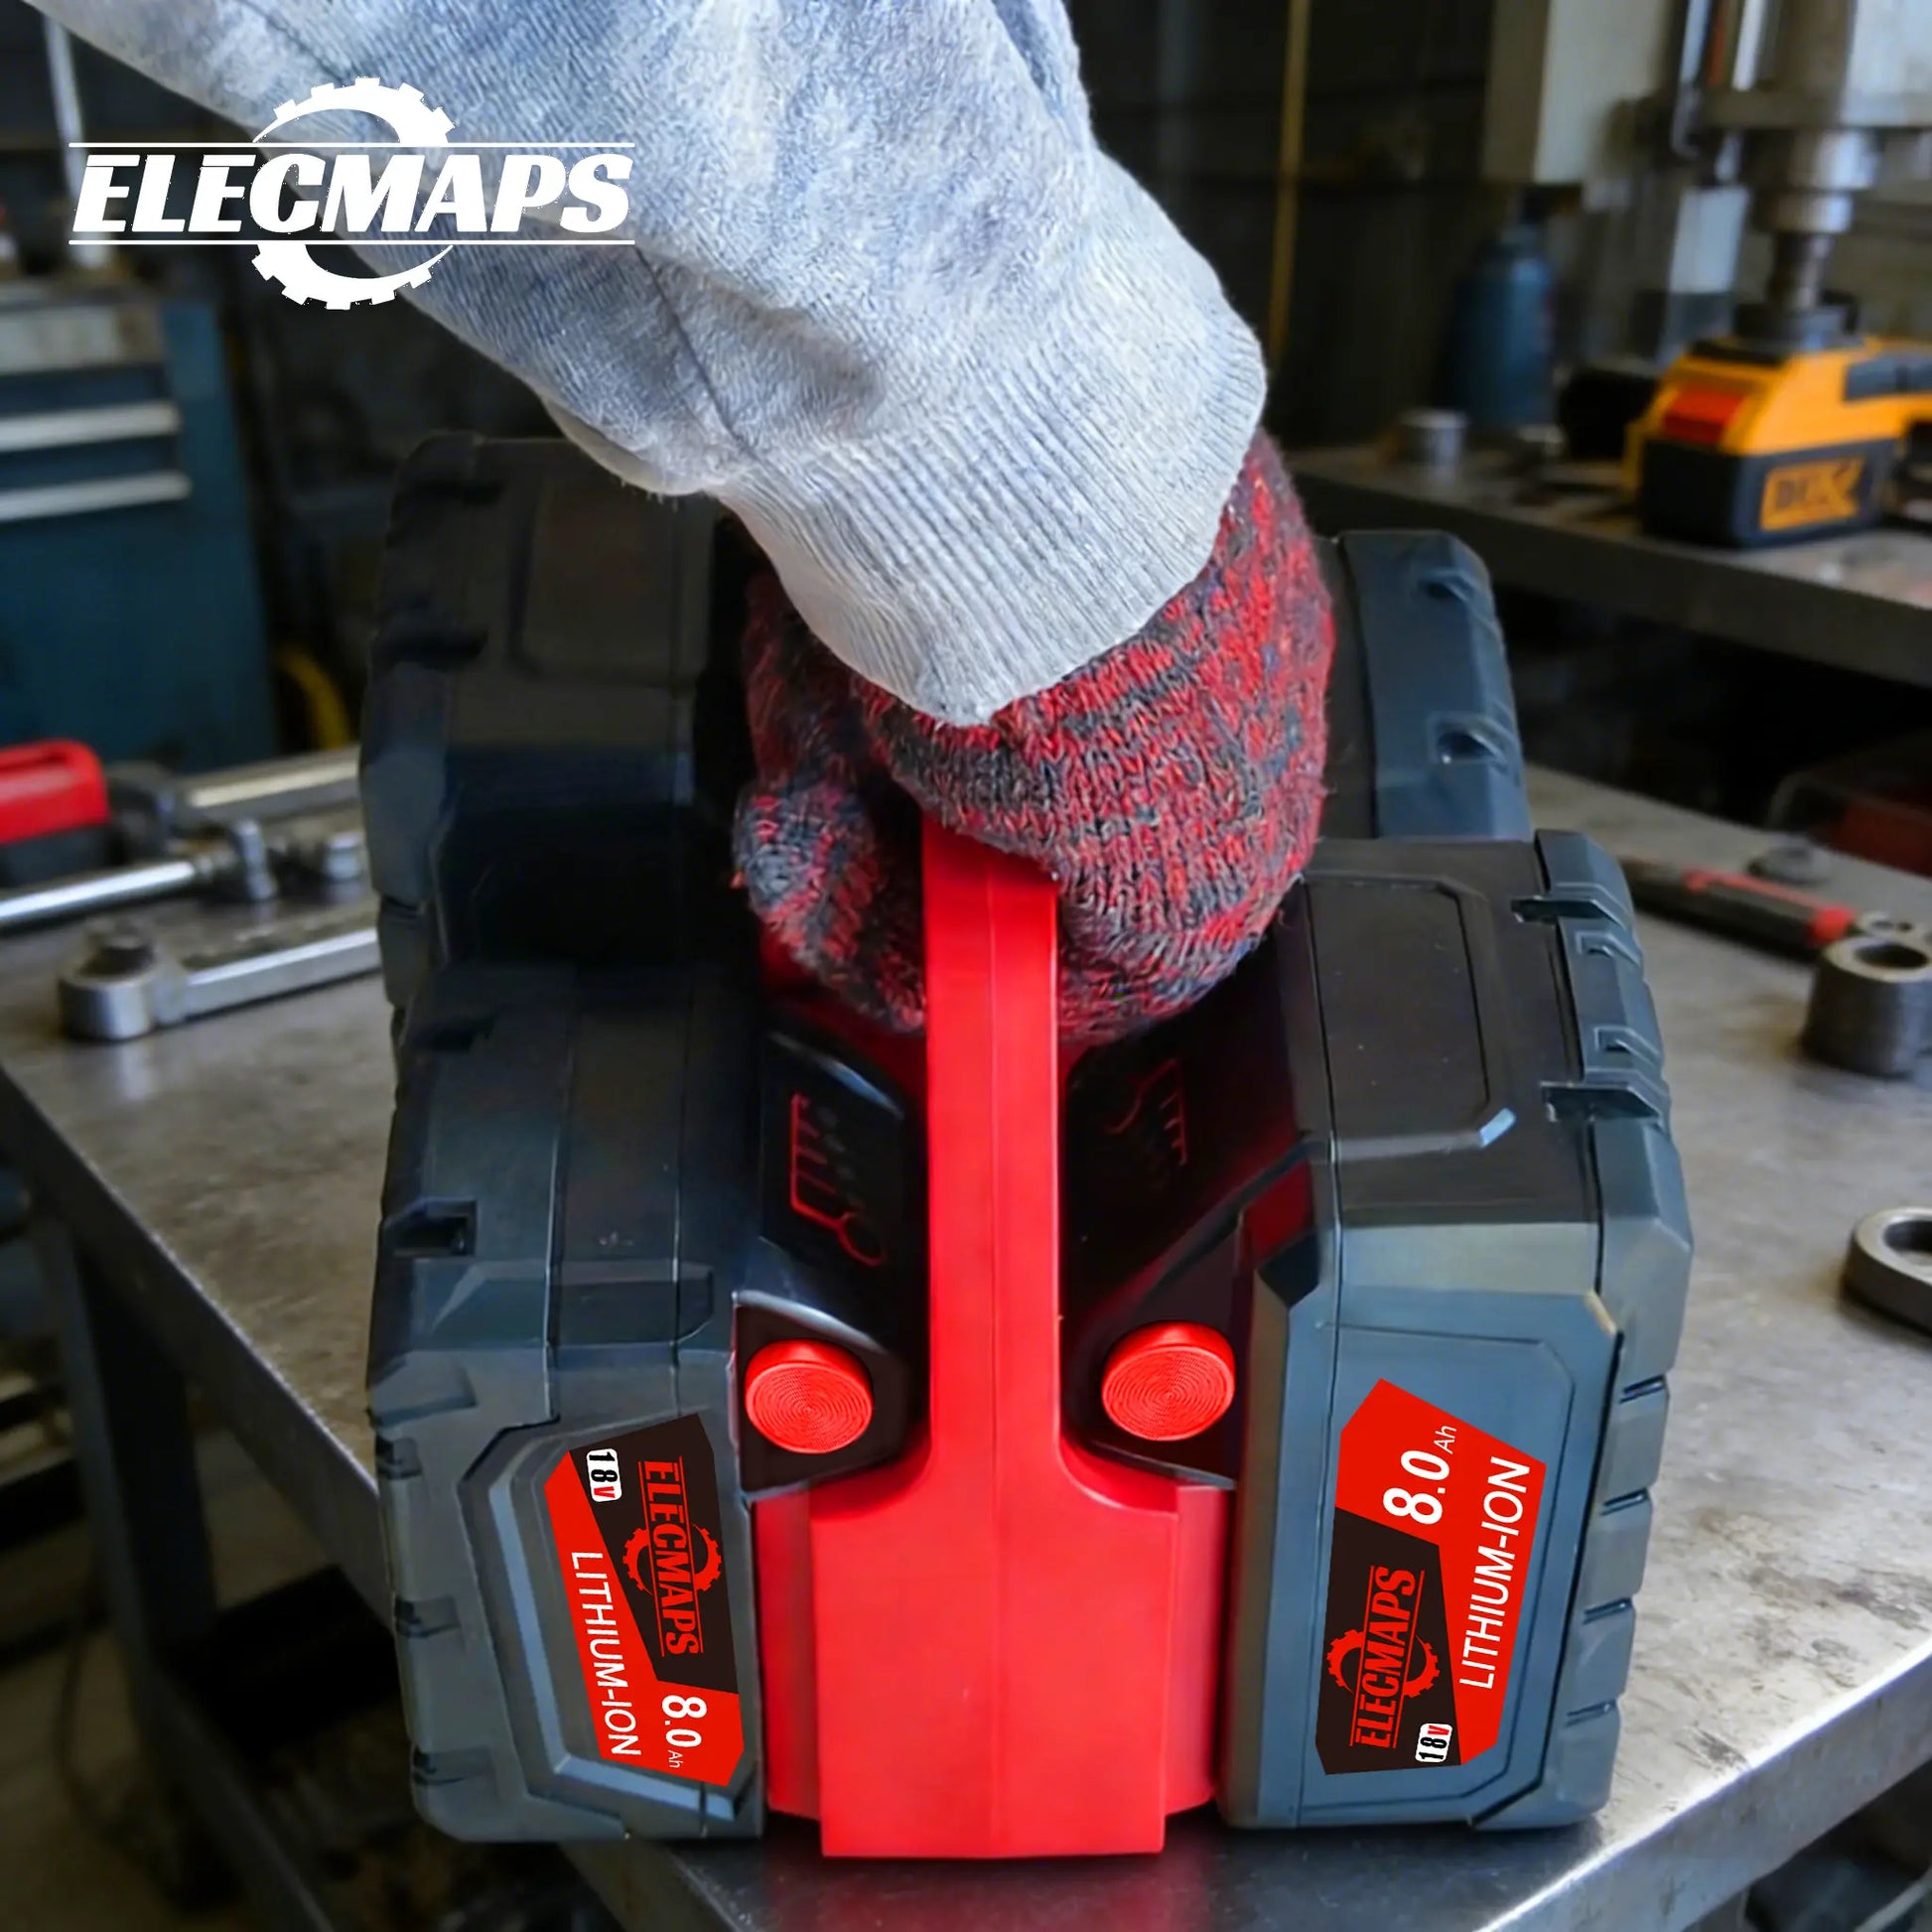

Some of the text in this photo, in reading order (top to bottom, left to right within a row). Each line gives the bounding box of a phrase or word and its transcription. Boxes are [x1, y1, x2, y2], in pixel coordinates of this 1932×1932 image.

[589, 1451, 618, 1498] 18V
[644, 1461, 700, 1656] ELECMAPS
[571, 1552, 642, 1755] LITHIUM-ION
[1355, 1566, 1416, 1748] ELECMAPS
[1459, 1455, 1530, 1690] LITHIUM-ION
[1419, 1725, 1449, 1759] 18V
